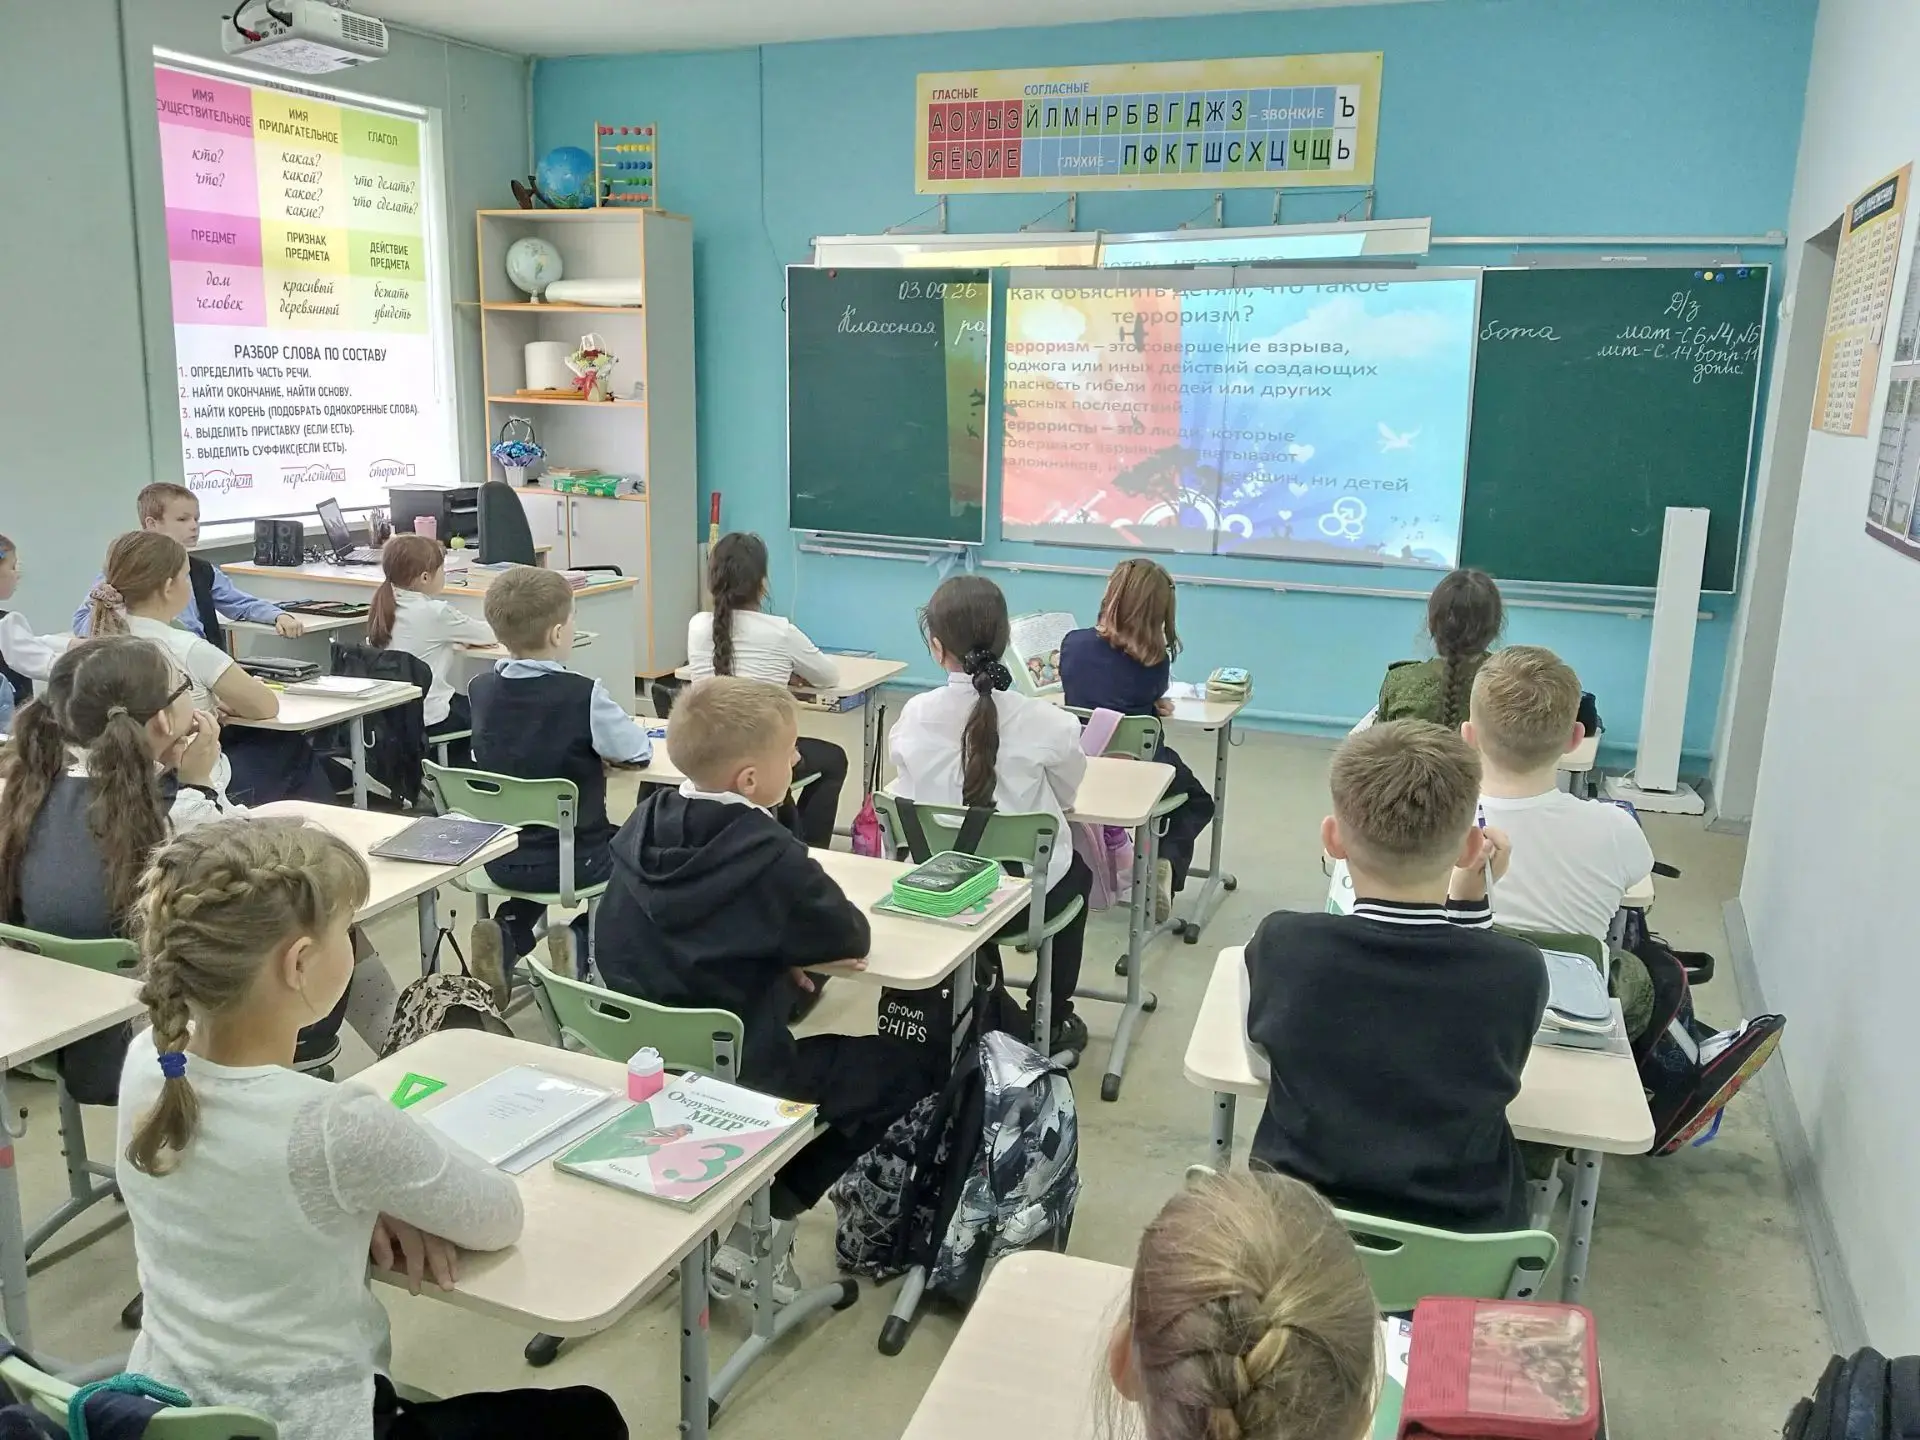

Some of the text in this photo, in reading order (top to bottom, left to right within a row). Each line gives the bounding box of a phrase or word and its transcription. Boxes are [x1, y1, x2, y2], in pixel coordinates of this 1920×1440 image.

[192, 88, 214, 103] ИМЯ
[932, 88, 979, 100] ГЛАСНЫЕ
[1024, 82, 1090, 95] СОГЛАСНЫЕ
[156, 98, 251, 128] СУЩЕСТВИТЕЛЬНОЕ
[289, 107, 309, 122] ИМЯ
[1261, 107, 1325, 121] ЗВОНКИЕ
[259, 118, 339, 144] ПРИЛАГАТЕЛЬНОЕ
[368, 131, 398, 146] ГЛАГОЛ
[192, 148, 224, 163] кто?
[281, 151, 321, 167] какая?
[1058, 155, 1105, 168] ГЛУХИЕ
[195, 172, 225, 187] что?
[282, 170, 323, 184] какой?
[354, 175, 416, 194] что делать?
[284, 187, 323, 201] какое?
[286, 204, 324, 219] какие?
[352, 195, 418, 215] что сделать?
[191, 229, 237, 245] ПРЕДМЕТ
[286, 231, 326, 246] ПРИЗНАК
[285, 247, 330, 262] ПРЕДМЕТА
[370, 241, 409, 256] ДЕЙСТВИЕ
[370, 256, 410, 271] ПРЕДМЕТА
[206, 270, 231, 286] дом
[283, 278, 335, 298] красивый
[374, 281, 409, 299] бежать
[1010, 288, 1044, 301] Как
[1316, 282, 1390, 293] такое
[196, 294, 243, 311] человек
[279, 298, 340, 320] деревянный
[372, 303, 412, 325] увидеть
[1112, 304, 1254, 327] терроризм?
[1480, 320, 1561, 342] бота
[234, 345, 387, 362] РАЗБОР СЛОВА ПО СОСТАВУ
[1005, 341, 1350, 356] ерроризм это совершение взрыва,
[178, 366, 312, 379] 1. ОПРЕДЕЛИТЬ ЧАСТЬ РЕЧИ.
[1004, 360, 1379, 377] оджога или иных действий создающих
[180, 384, 352, 398] 2. НАЙТИ ОКОНЧАНИЕ, НАЙТИ ОСНОВУ.
[1085, 378, 1146, 392] гибели
[1151, 382, 1213, 395] людей
[1218, 383, 1255, 395] или
[1260, 384, 1332, 399] других
[181, 407, 191, 419] 3.
[194, 404, 225, 418] НАЙТИ
[228, 406, 266, 418] КОРЕНЬ
[268, 405, 322, 419] (ПОДОБРАТЬ
[323, 404, 388, 417] ОДНОКОРЕННЫЕ
[1071, 400, 1190, 414] последствий.
[183, 423, 354, 439] 4. ВЫДЕЛИТЬ ПРИСТАВКУ (ЕСЛИ ЕСТЬ).
[1211, 430, 1296, 442] которые
[185, 448, 195, 460] 5.
[197, 446, 250, 460] ВЫДЕЛИТЬ
[322, 442, 347, 454] ЕСТЬ).
[1311, 477, 1337, 487] ни
[1343, 478, 1410, 492] детей
[887, 1001, 924, 1021] Brown
[877, 1015, 928, 1044] CHIPS
[667, 1090, 771, 1128] Окружающий
[685, 1109, 745, 1132] МИР
